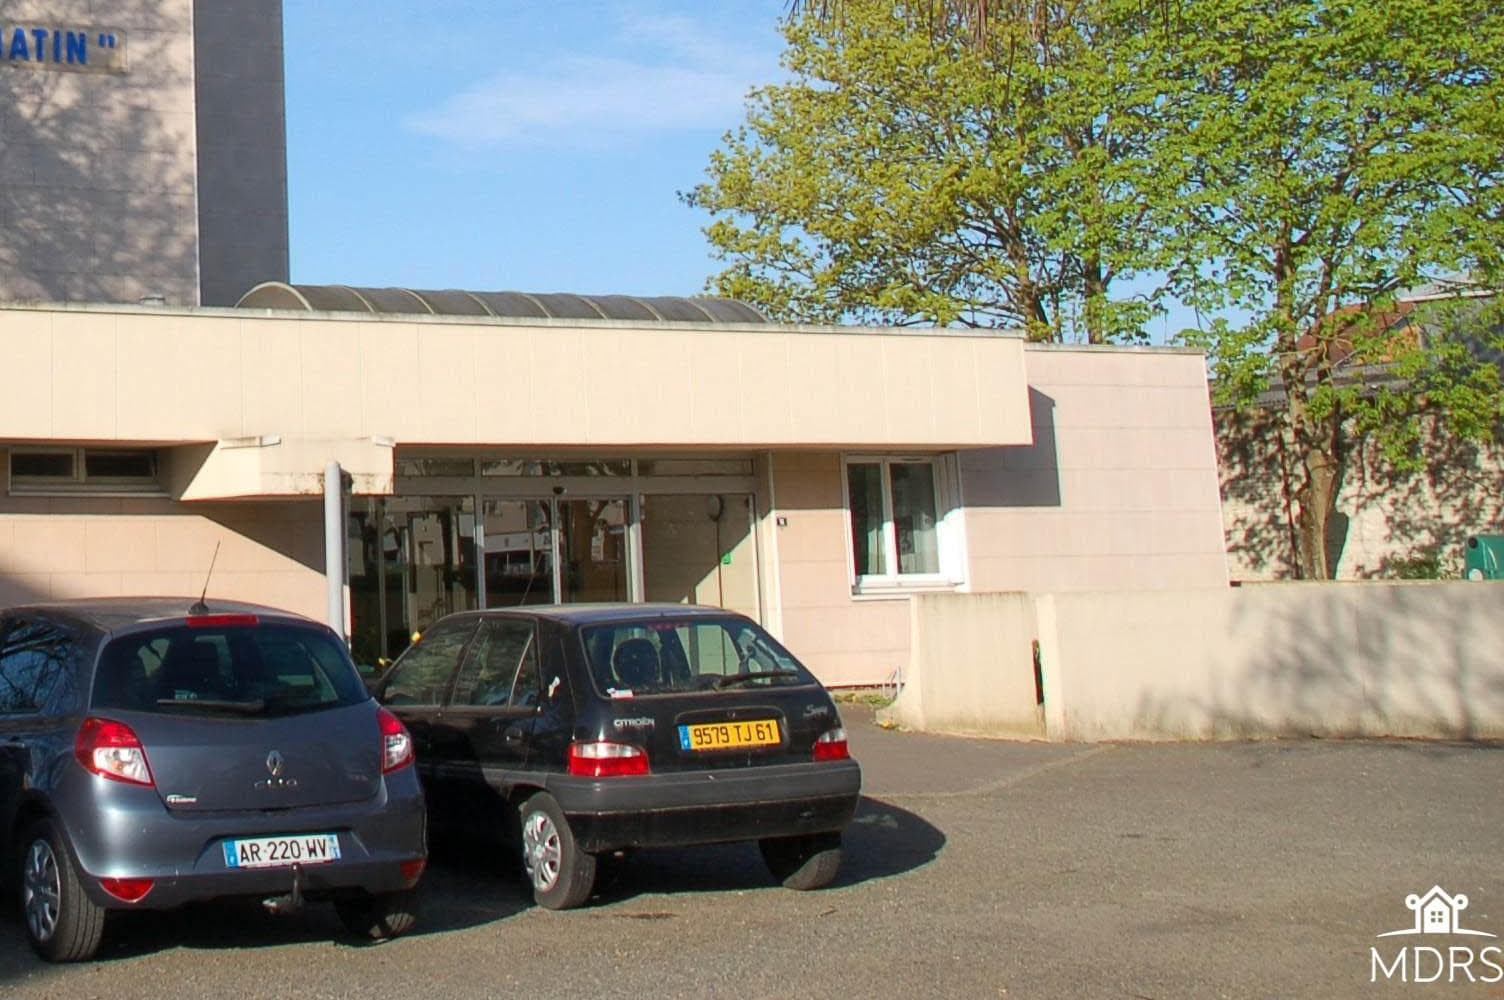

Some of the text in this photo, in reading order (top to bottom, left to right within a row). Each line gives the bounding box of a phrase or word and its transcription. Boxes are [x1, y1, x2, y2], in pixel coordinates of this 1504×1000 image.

[694, 722, 774, 745] 9579 TJ 61
